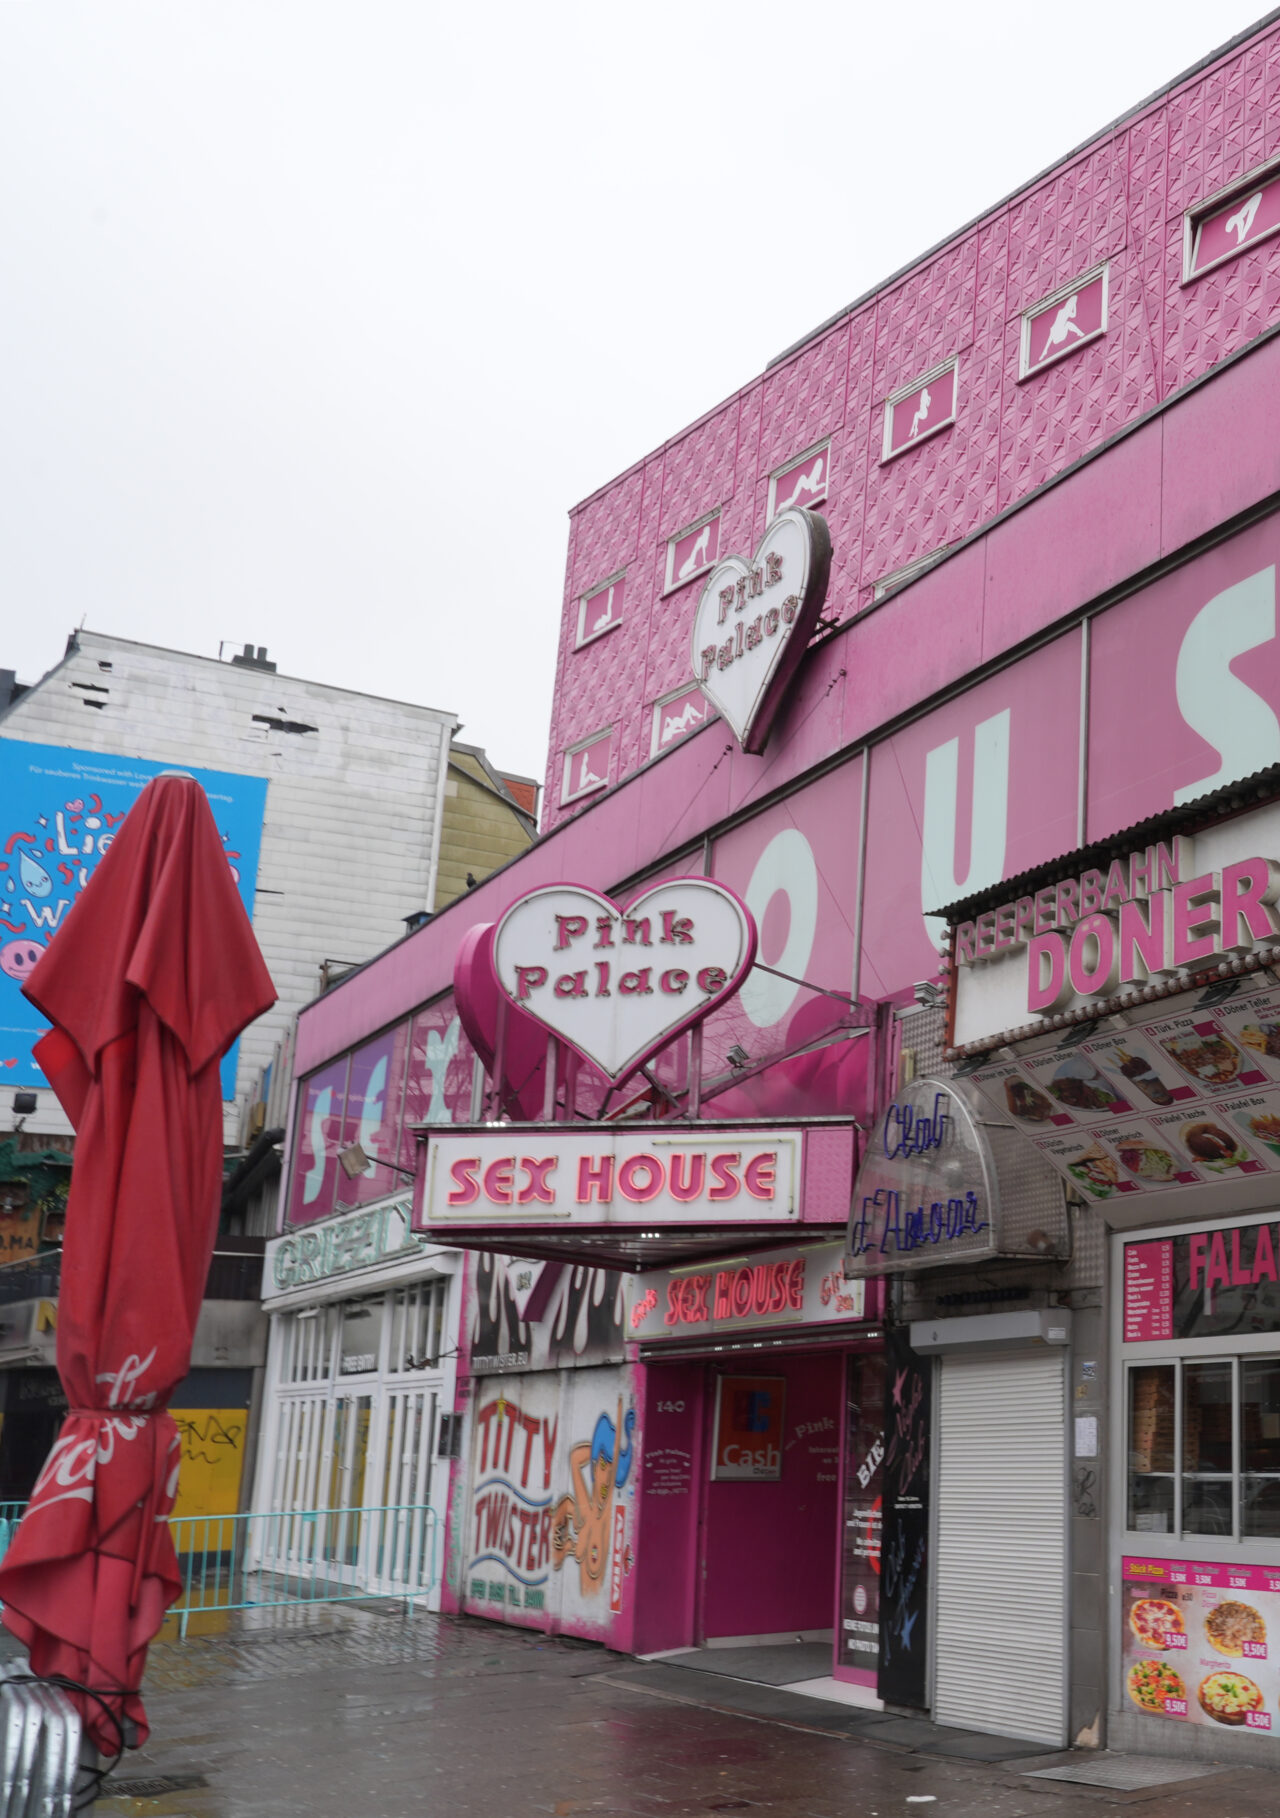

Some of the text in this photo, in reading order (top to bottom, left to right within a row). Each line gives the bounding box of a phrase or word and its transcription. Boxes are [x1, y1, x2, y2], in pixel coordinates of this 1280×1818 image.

[717, 552, 783, 625] Pink
[701, 594, 799, 680] Palace
[956, 835, 1190, 967] REEPERBAHN
[554, 910, 695, 951] Pink
[513, 962, 728, 1001] Palace
[447, 1152, 777, 1205] SEX HOUSE
[665, 1258, 807, 1325] SEX HOUSE
[656, 1401, 685, 1412] 140
[794, 1417, 835, 1439] Pink
[478, 1399, 558, 1490] TITTY
[723, 1443, 780, 1467] Cash
[475, 1491, 553, 1571] TWISTER
[1165, 1634, 1187, 1647] 9,50€
[1243, 1642, 1267, 1657] 9,50€
